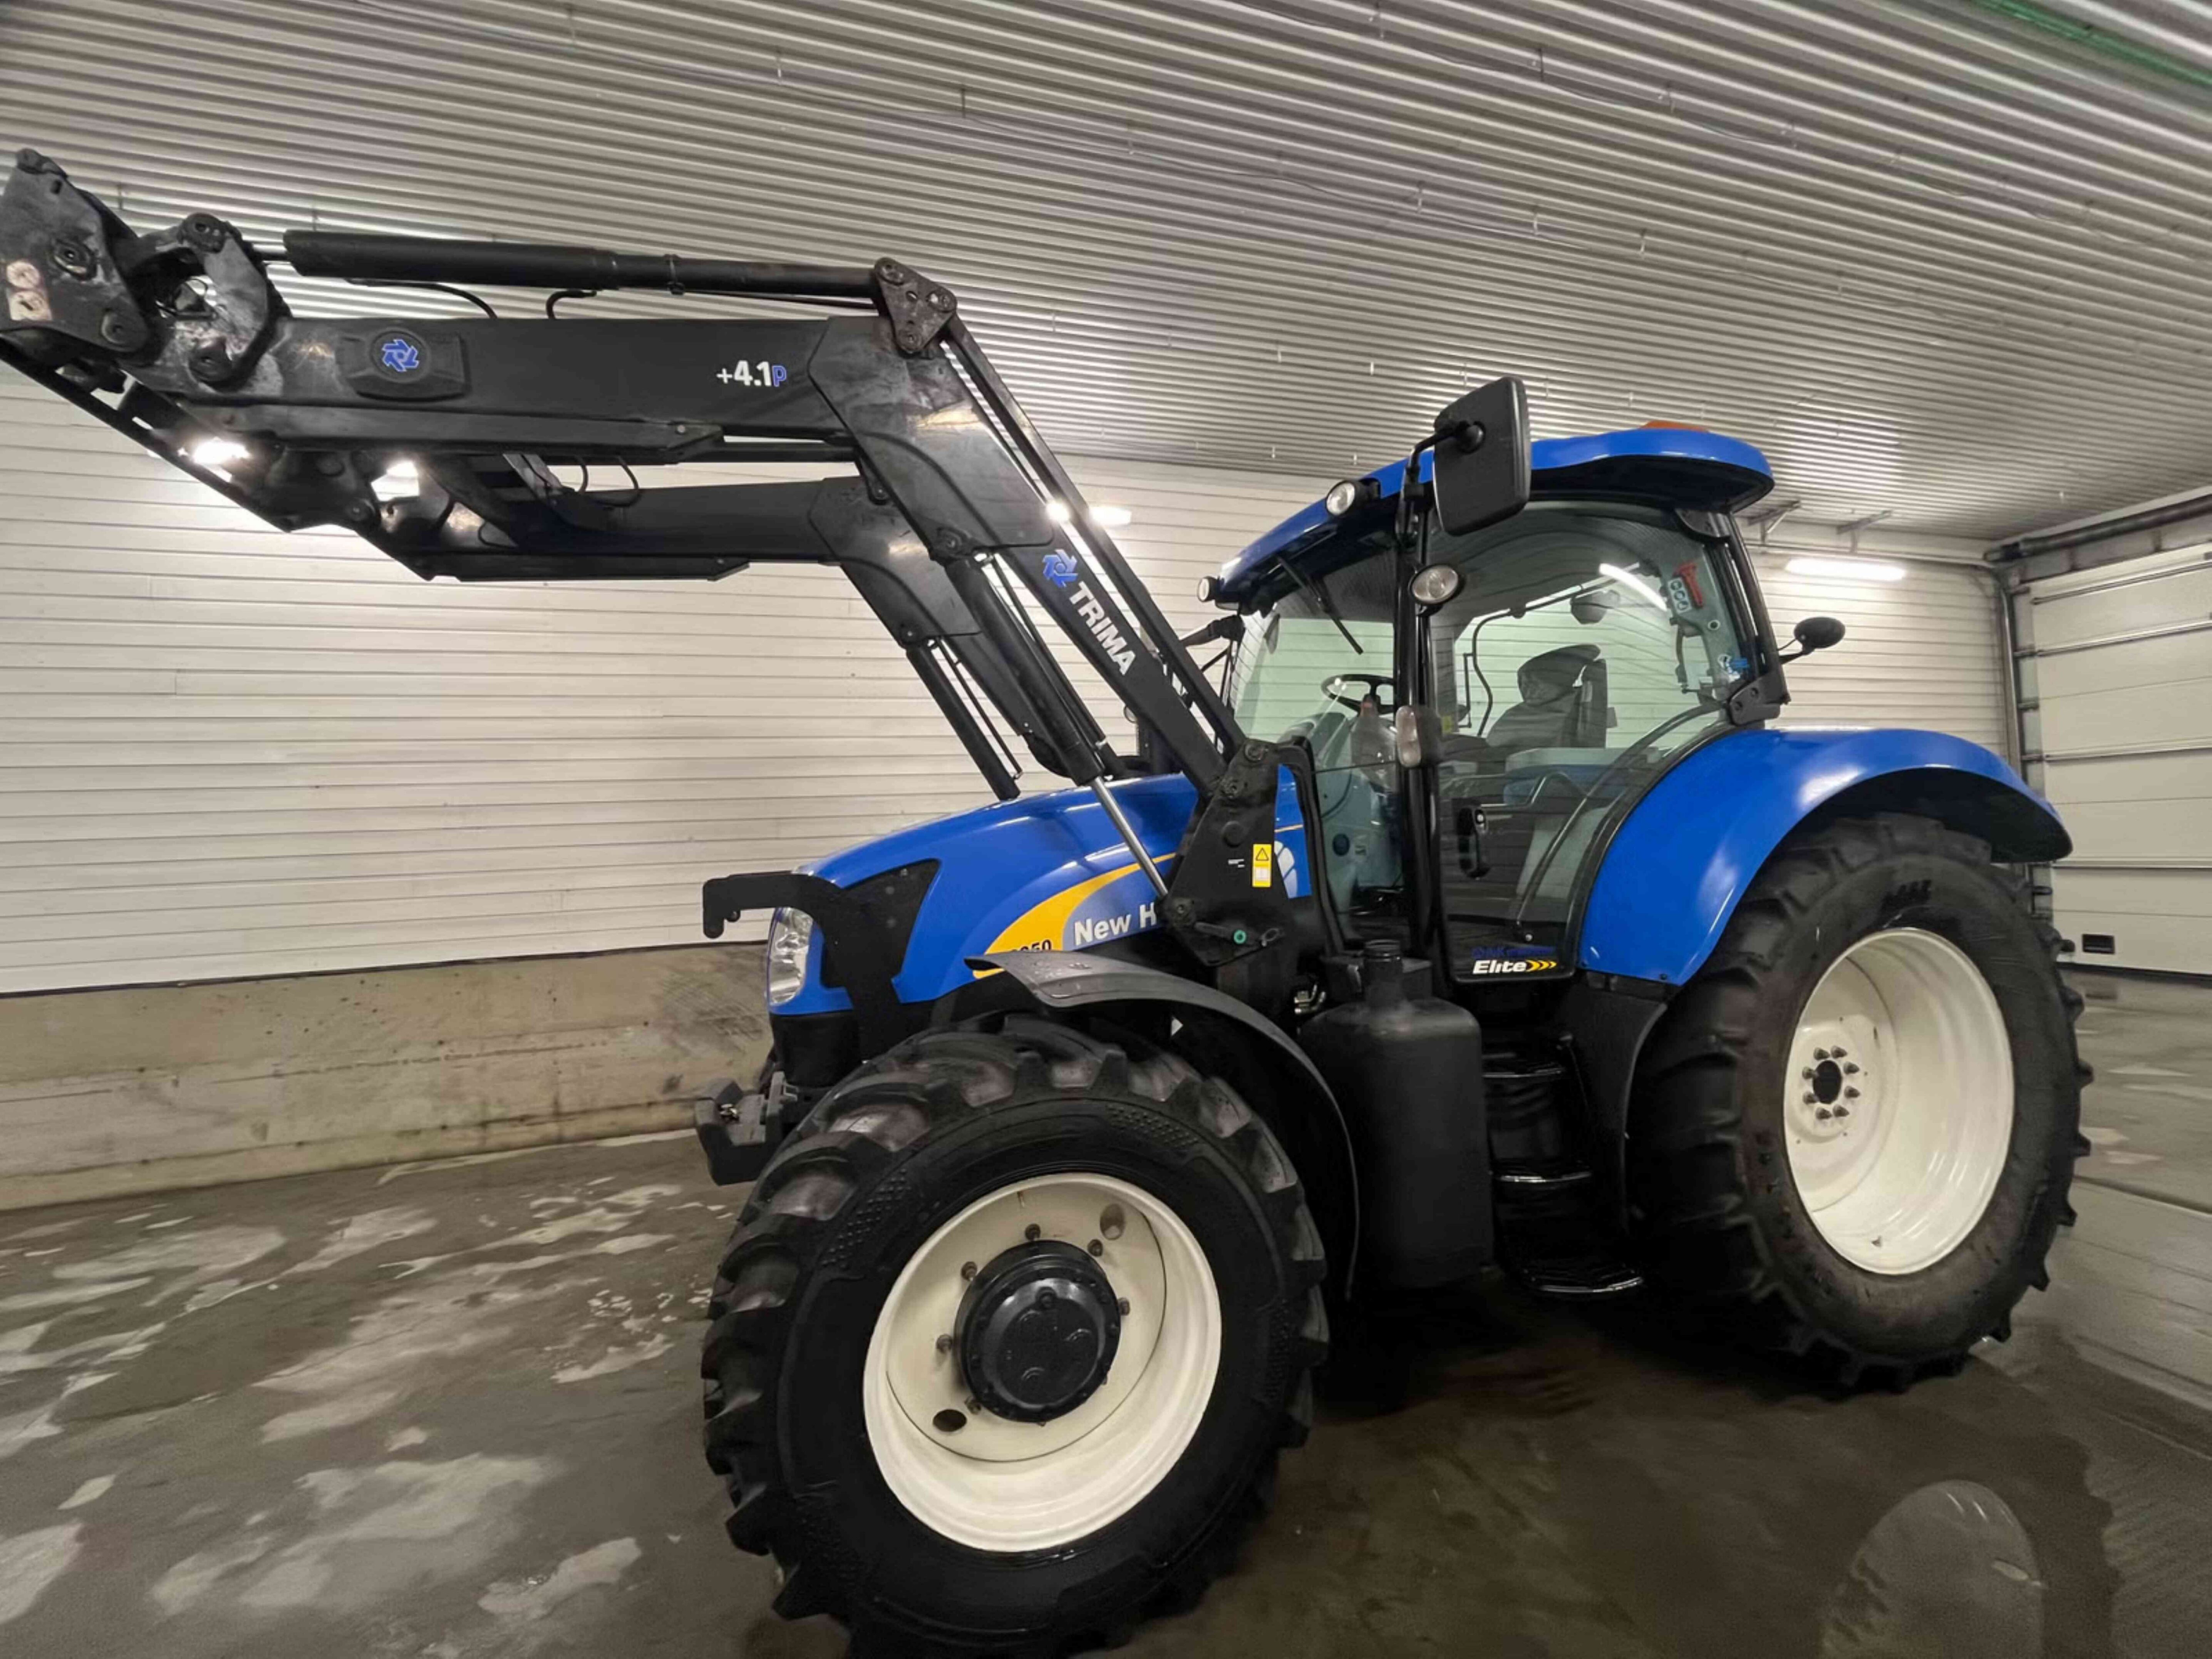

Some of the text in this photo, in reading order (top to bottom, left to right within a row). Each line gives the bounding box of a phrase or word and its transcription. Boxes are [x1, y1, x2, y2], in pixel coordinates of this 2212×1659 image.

[1069, 581, 1135, 675] TRIMA
[1074, 914, 1131, 945] New
[1473, 960, 1527, 974] Elite
